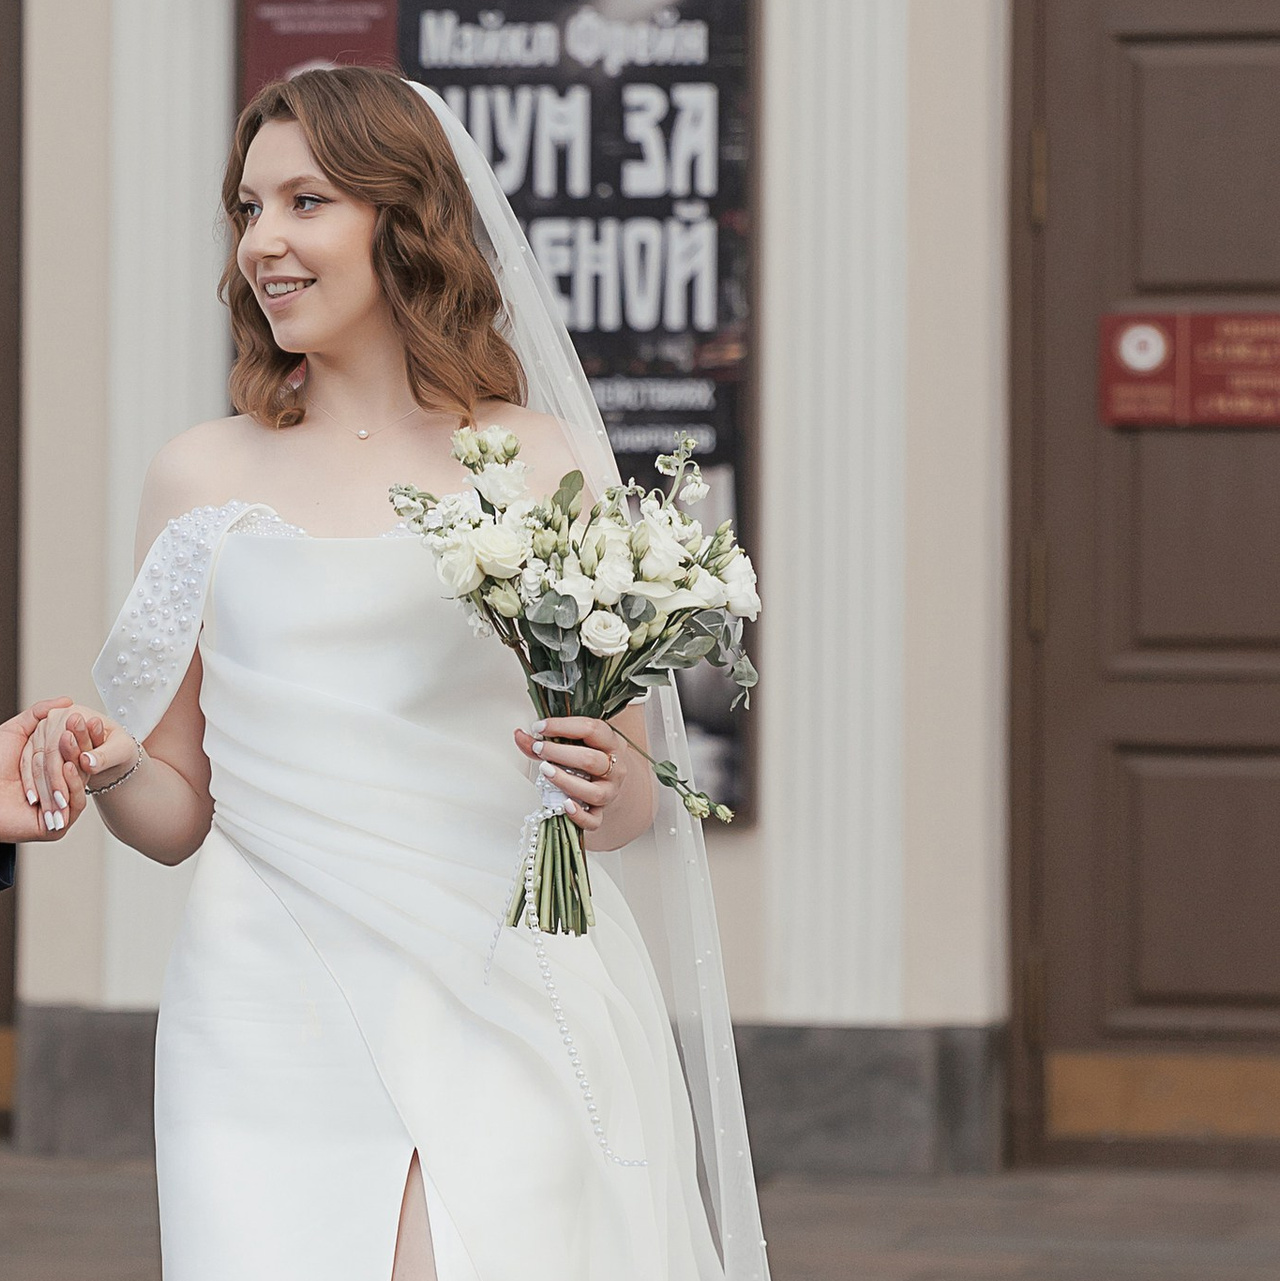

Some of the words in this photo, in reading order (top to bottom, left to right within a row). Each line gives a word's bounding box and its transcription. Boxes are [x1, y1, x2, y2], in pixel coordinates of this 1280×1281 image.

[420, 9, 559, 69] Майкл
[566, 7, 707, 76] Фрейн
[621, 83, 718, 198] ЗА
